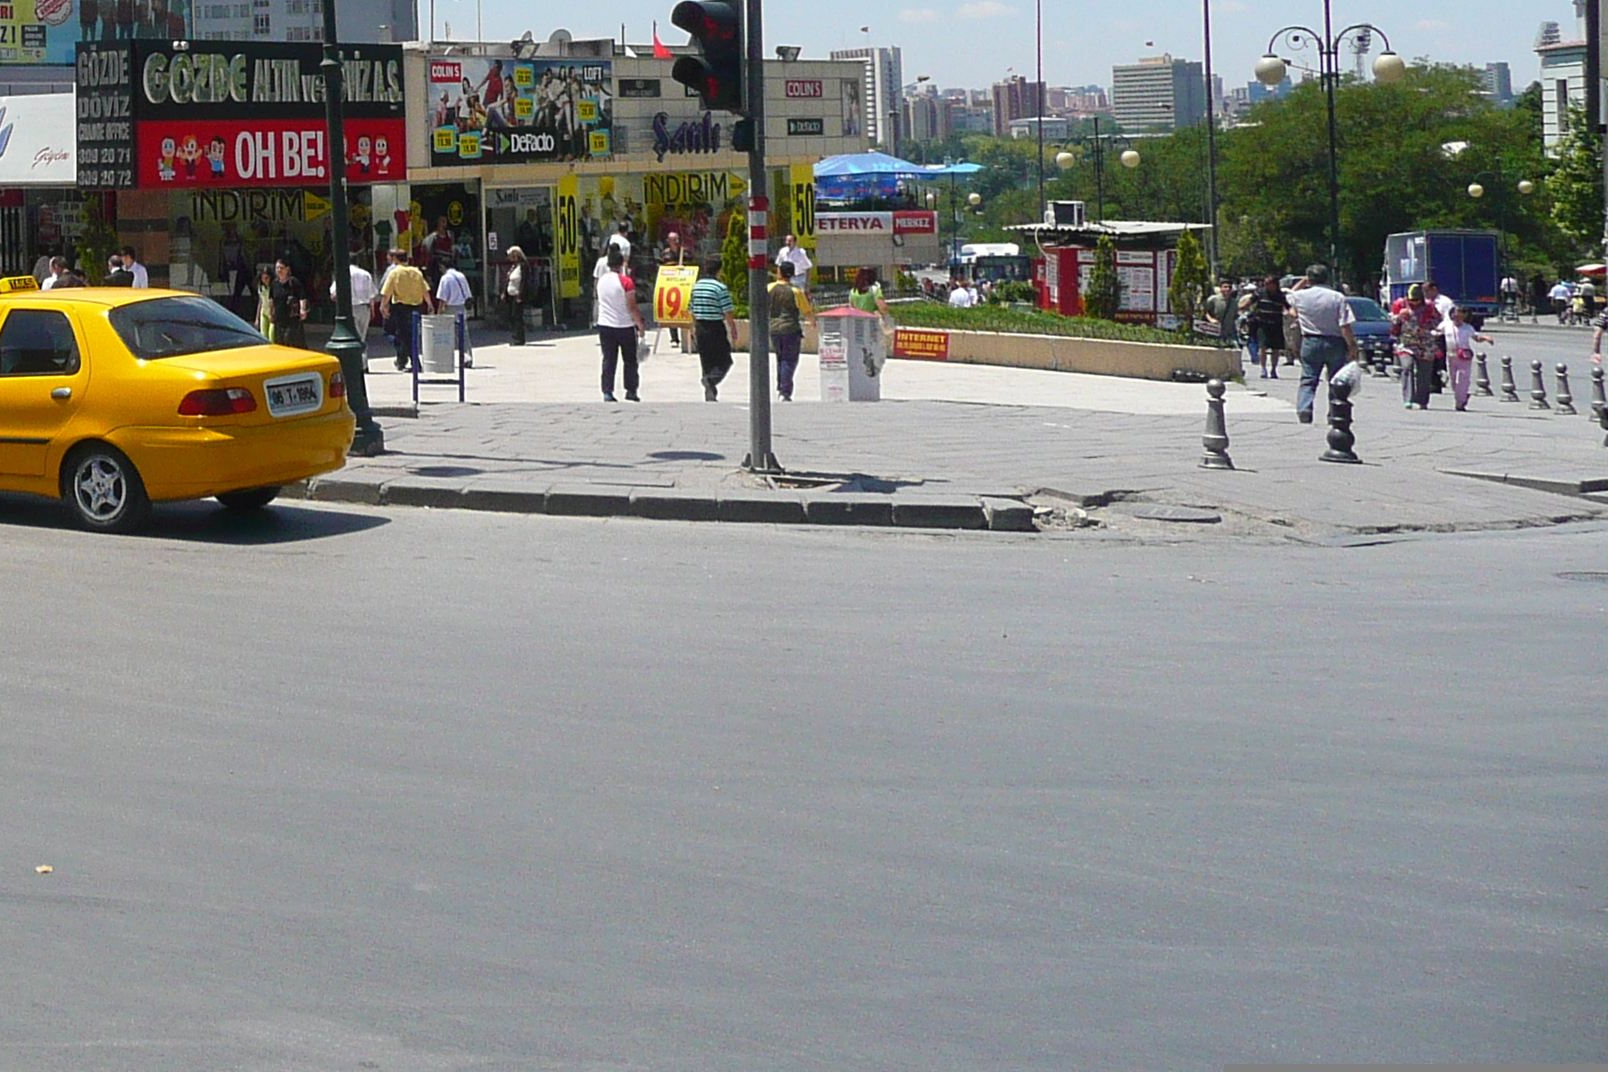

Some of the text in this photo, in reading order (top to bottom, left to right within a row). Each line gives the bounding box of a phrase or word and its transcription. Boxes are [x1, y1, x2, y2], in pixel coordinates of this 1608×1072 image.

[78, 44, 129, 87] GÖZDE
[143, 40, 247, 104] GÖZDE
[252, 59, 300, 102] ALTIN
[584, 67, 602, 80] LOFT
[78, 91, 130, 118] DÖVİZ
[78, 148, 131, 164] 309 20 71
[235, 131, 325, 178] OH BE!
[510, 133, 555, 154] DeFacto
[78, 170, 131, 186] 309 20 72
[644, 173, 728, 204] İNDİRİM
[192, 188, 303, 222] İNDİRİM
[795, 182, 815, 236] 50
[559, 194, 576, 255] 50
[815, 217, 930, 230] ETERYA MERKEZ
[897, 331, 946, 343] INTERNET
[272, 389, 284, 405] 06
